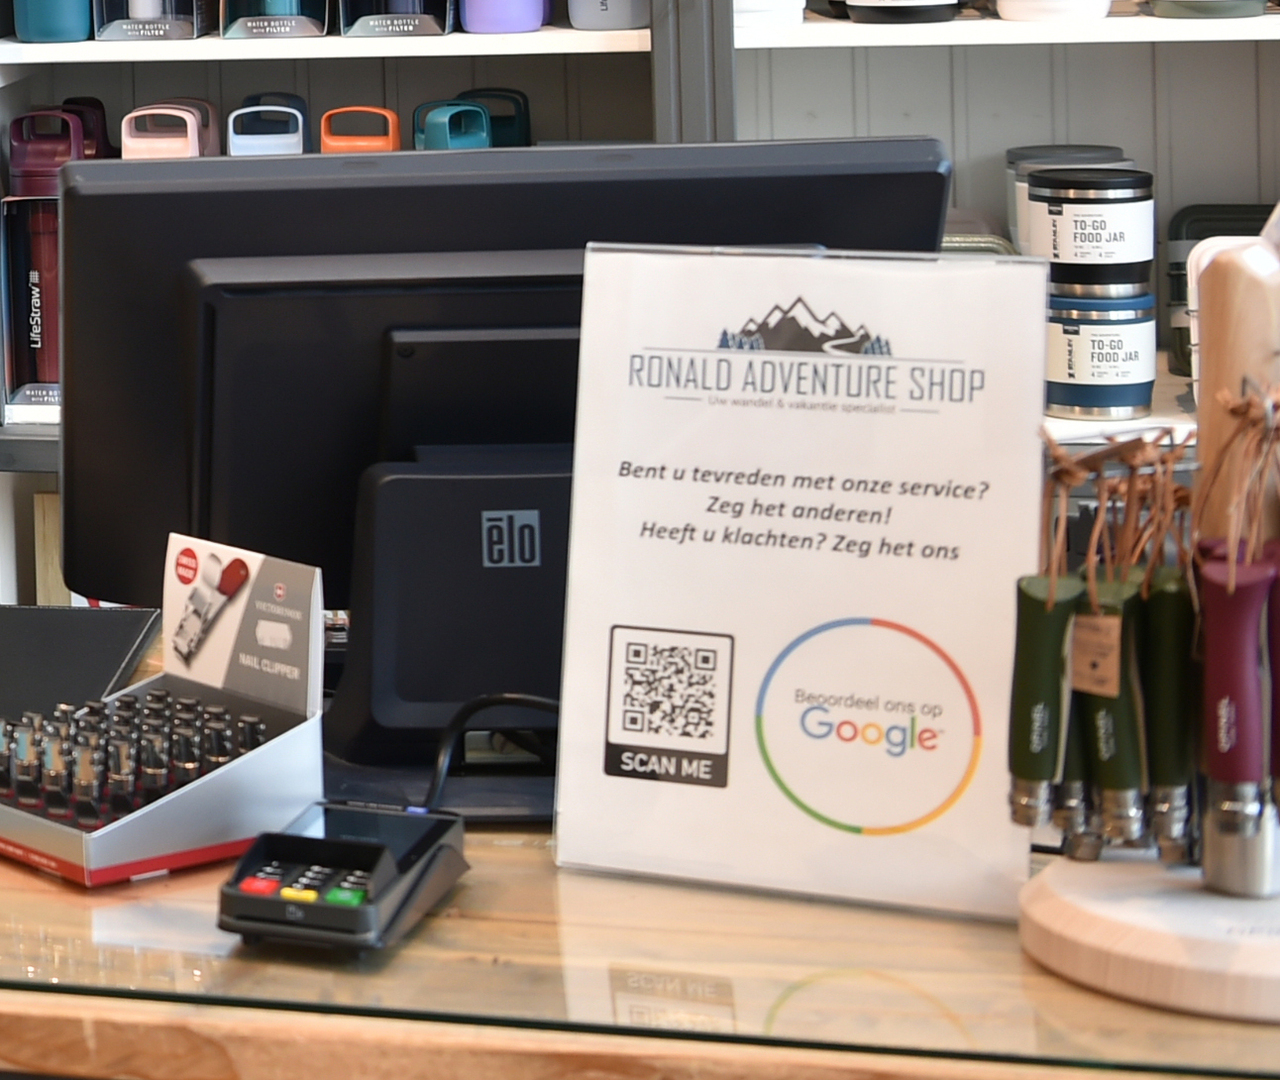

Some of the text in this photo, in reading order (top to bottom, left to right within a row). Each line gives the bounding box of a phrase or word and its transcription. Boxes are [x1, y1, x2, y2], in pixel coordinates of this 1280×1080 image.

[1073, 220, 1107, 231] TO-GO
[1074, 232, 1125, 243] FOOD JAR
[30, 287, 41, 348] LifeStraw
[1090, 340, 1124, 351] TO-GO
[1090, 351, 1139, 363] FOOD JAR
[629, 354, 986, 403] RONALD ADVENTURE SHOP
[708, 396, 727, 406] Uw
[730, 396, 774, 409] wandel
[787, 401, 838, 413] vakantie
[841, 402, 896, 415] specialist
[618, 460, 990, 501] Bent u tevreden met onze service?
[706, 496, 892, 525] Zeg het anderen!
[640, 521, 960, 560] Heeft u klachten? Zeg het ons
[239, 653, 300, 681] NAIL CLIPPER
[794, 688, 943, 719] Beoordeel ons op
[800, 705, 938, 757] Google
[620, 751, 713, 779] SCAN ME
